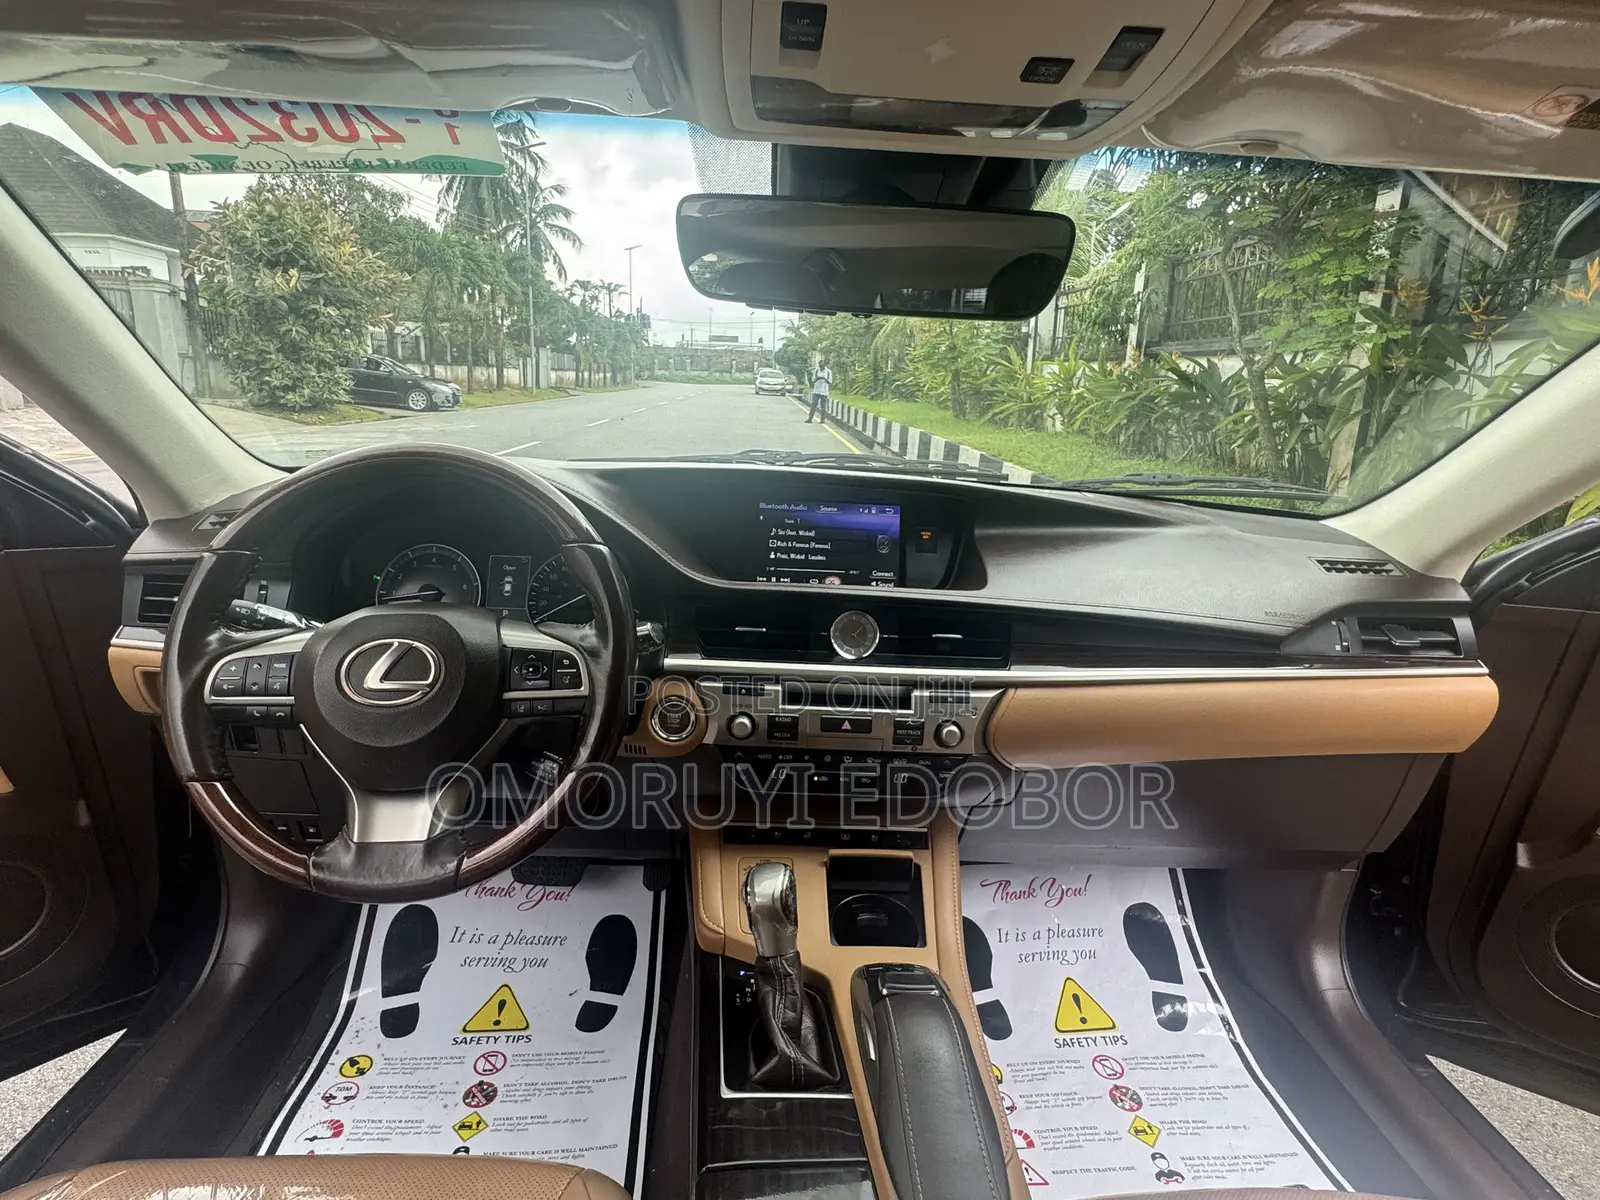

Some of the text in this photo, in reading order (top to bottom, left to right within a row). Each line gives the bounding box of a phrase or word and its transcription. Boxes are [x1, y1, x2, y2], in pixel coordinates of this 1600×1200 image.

[980, 873, 1093, 908] Thank You!
[449, 925, 568, 950] It is a pleasure
[996, 923, 1104, 946] It is a pleasure
[460, 952, 550, 974] serving you
[1017, 945, 1097, 966] serving you
[450, 1034, 533, 1046] SAFETY TIPS
[1054, 1034, 1128, 1048] SAFETY TIPS
[579, 1144, 618, 1152] MAINTAINED
